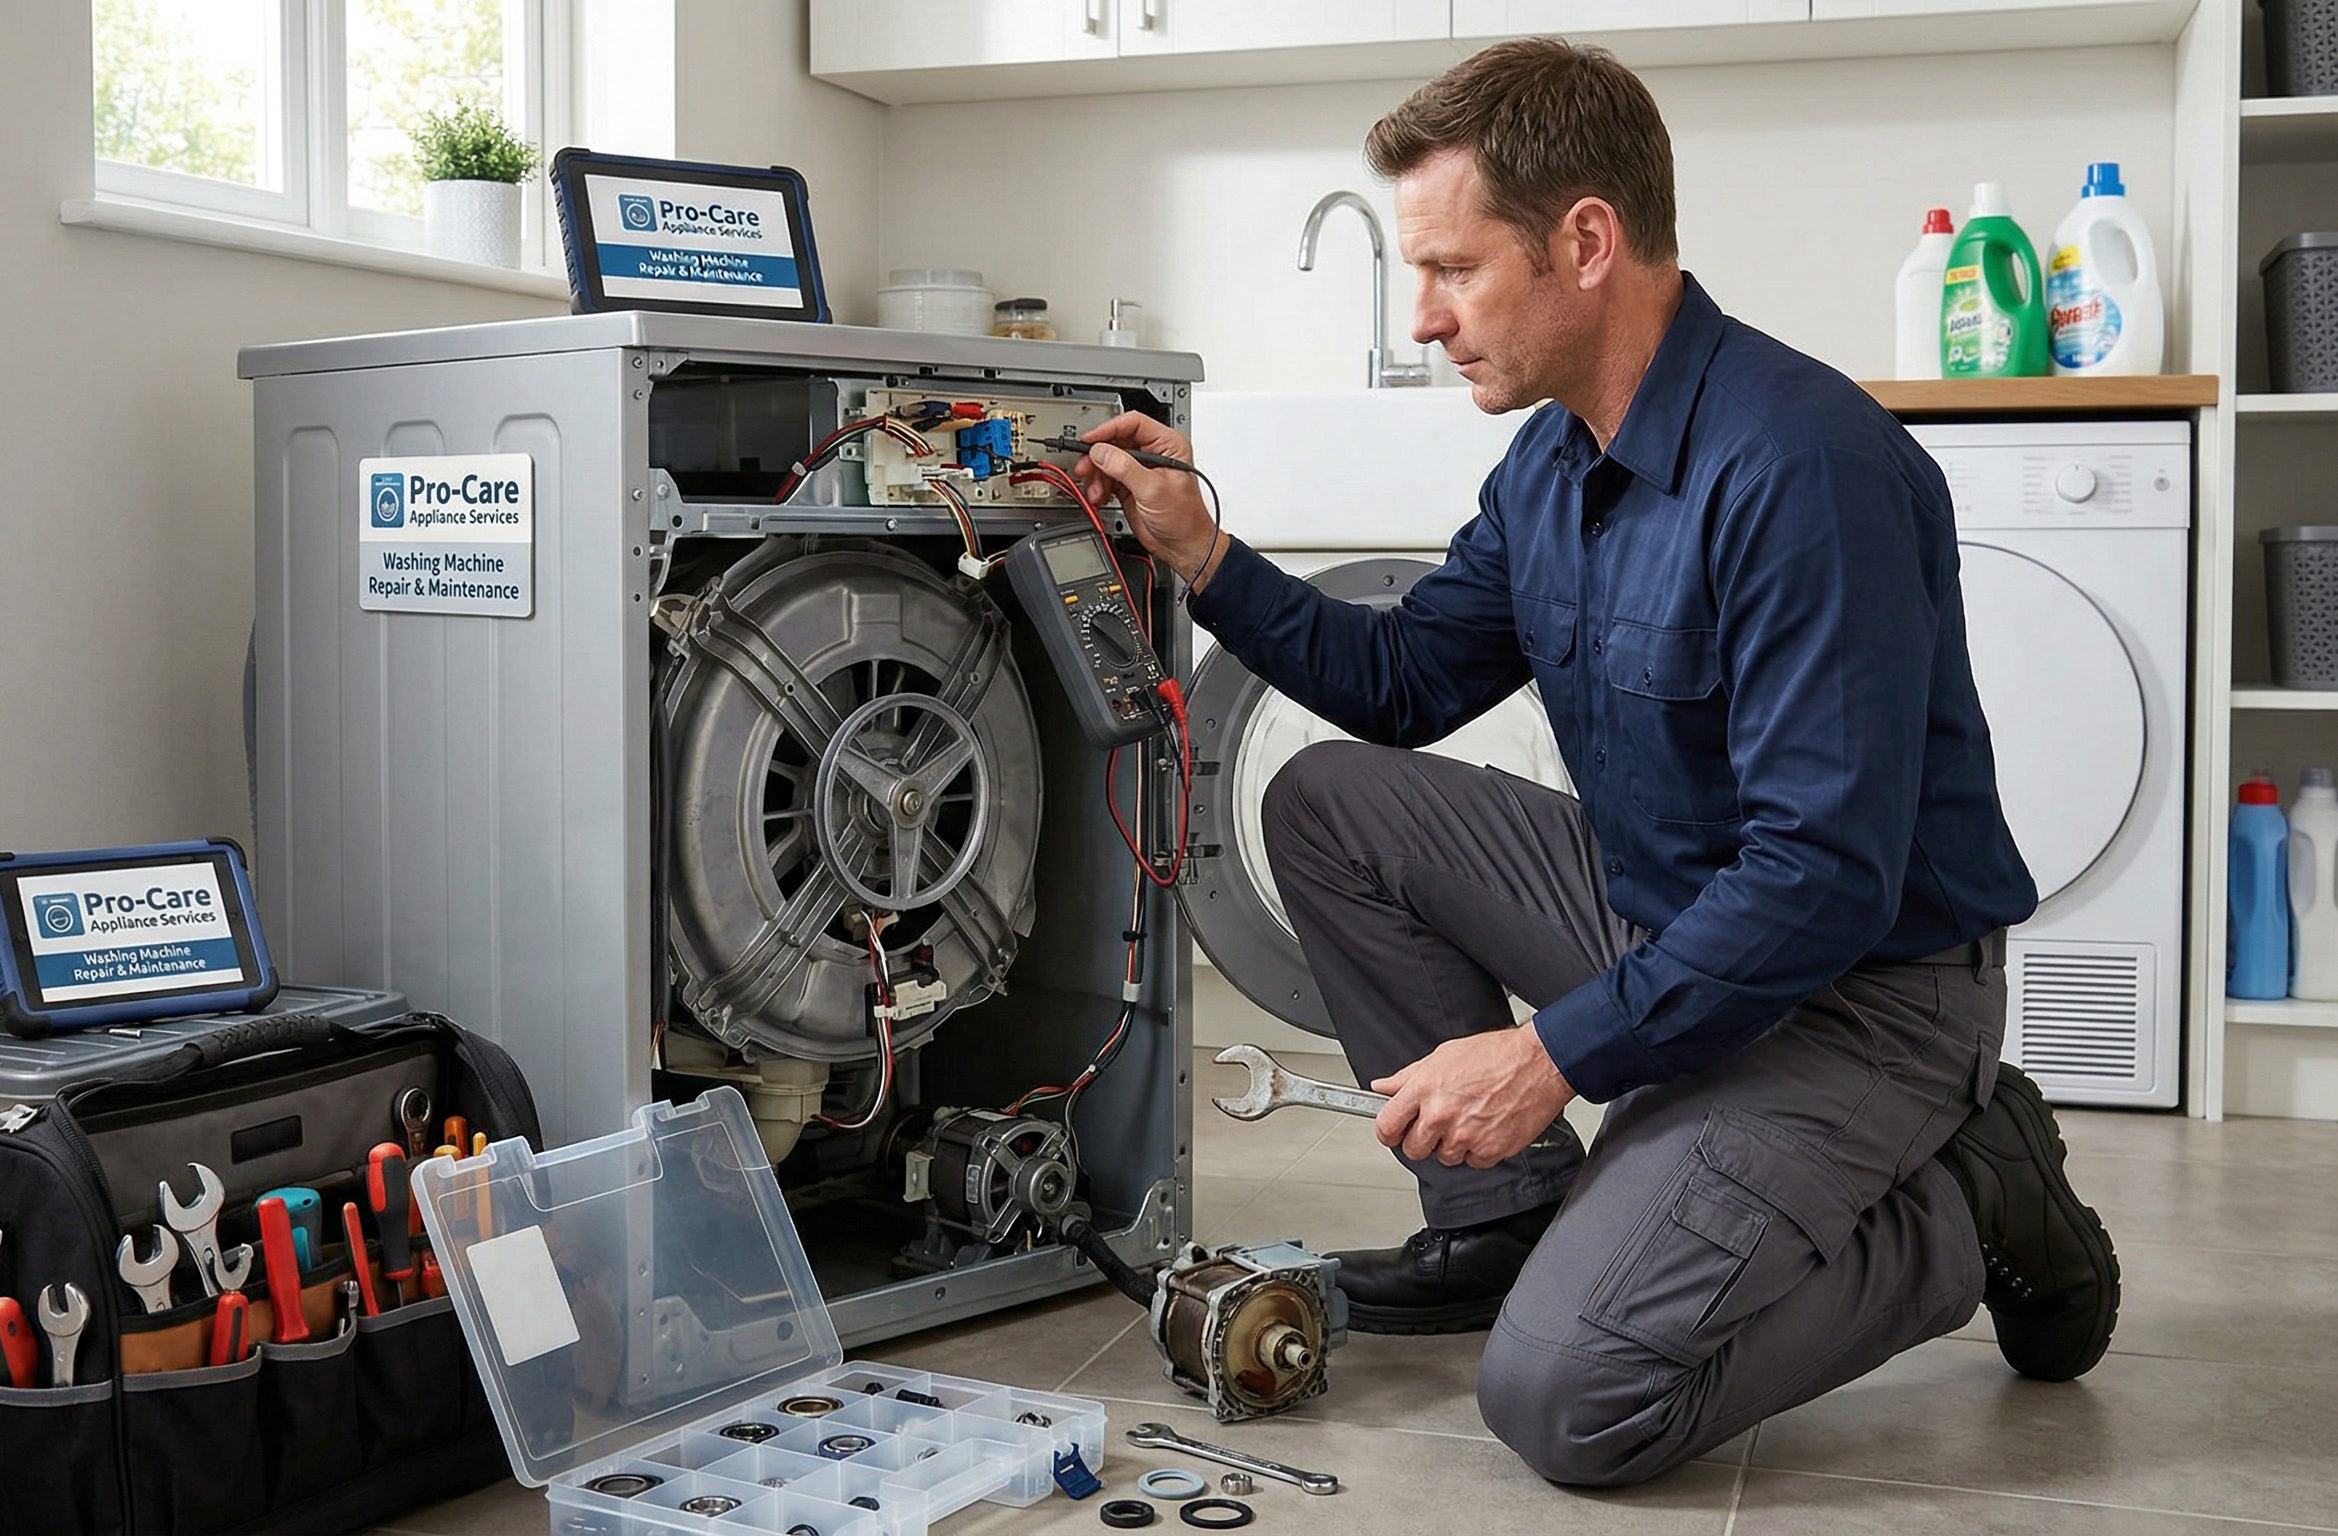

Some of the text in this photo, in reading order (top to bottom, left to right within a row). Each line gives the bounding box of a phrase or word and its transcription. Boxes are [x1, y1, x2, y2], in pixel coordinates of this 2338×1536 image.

[659, 200, 760, 227] Pro-Care
[409, 474, 519, 505] Pro-Care
[409, 508, 519, 528] Appliance Services
[383, 552, 504, 576] Washing Machine
[369, 576, 519, 600] Repair & Maintenance
[83, 887, 211, 916] Pro-Care
[90, 910, 216, 934] Appliance Services
[83, 944, 191, 965] Washing Machine
[73, 963, 114, 982] Repair
[117, 963, 127, 977] &
